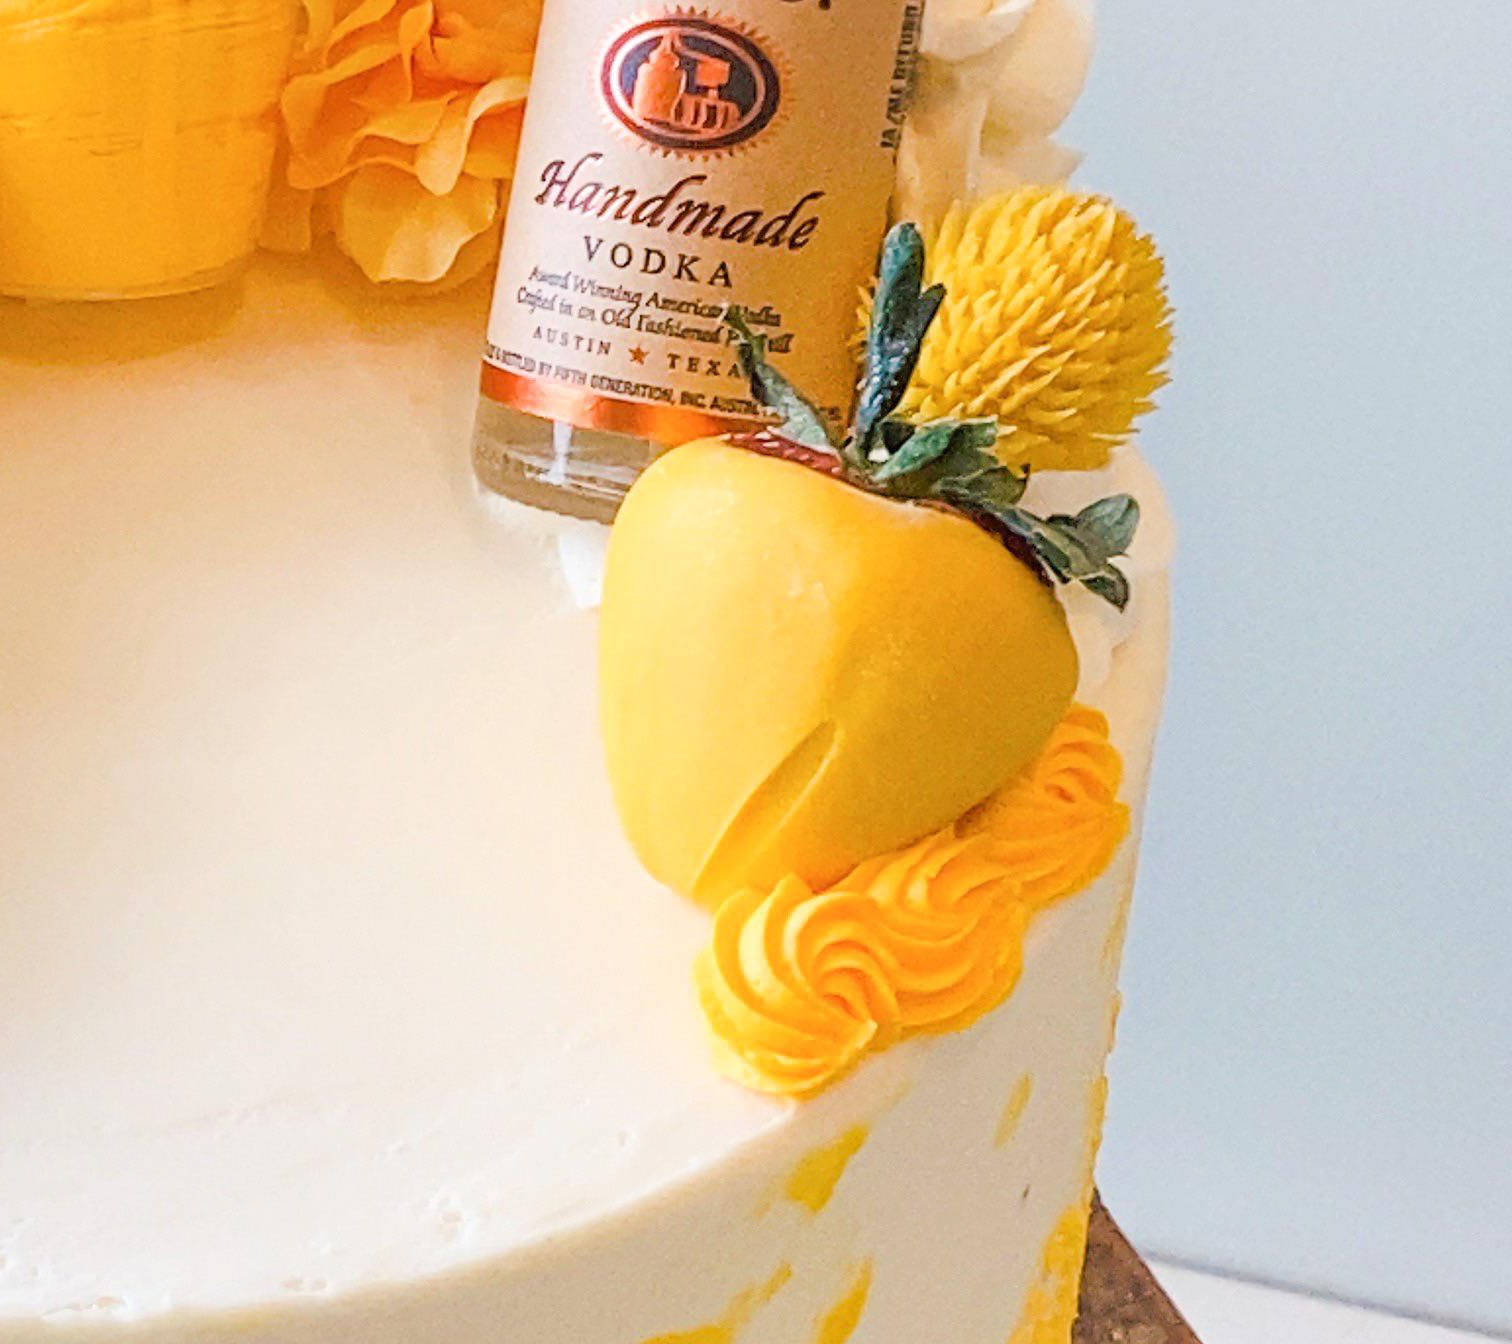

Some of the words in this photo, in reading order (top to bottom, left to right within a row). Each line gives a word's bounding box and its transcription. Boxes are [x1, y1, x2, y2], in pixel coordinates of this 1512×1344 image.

[535, 153, 826, 251] Handmade
[583, 234, 733, 288] VODKA
[572, 274, 641, 305] Winning
[559, 299, 573, 316] in
[602, 305, 639, 329] Old
[636, 314, 724, 342] Fashioned
[532, 325, 611, 355] AUSTIN
[667, 353, 741, 378] TEXA
[590, 374, 676, 406] GENERATION,
